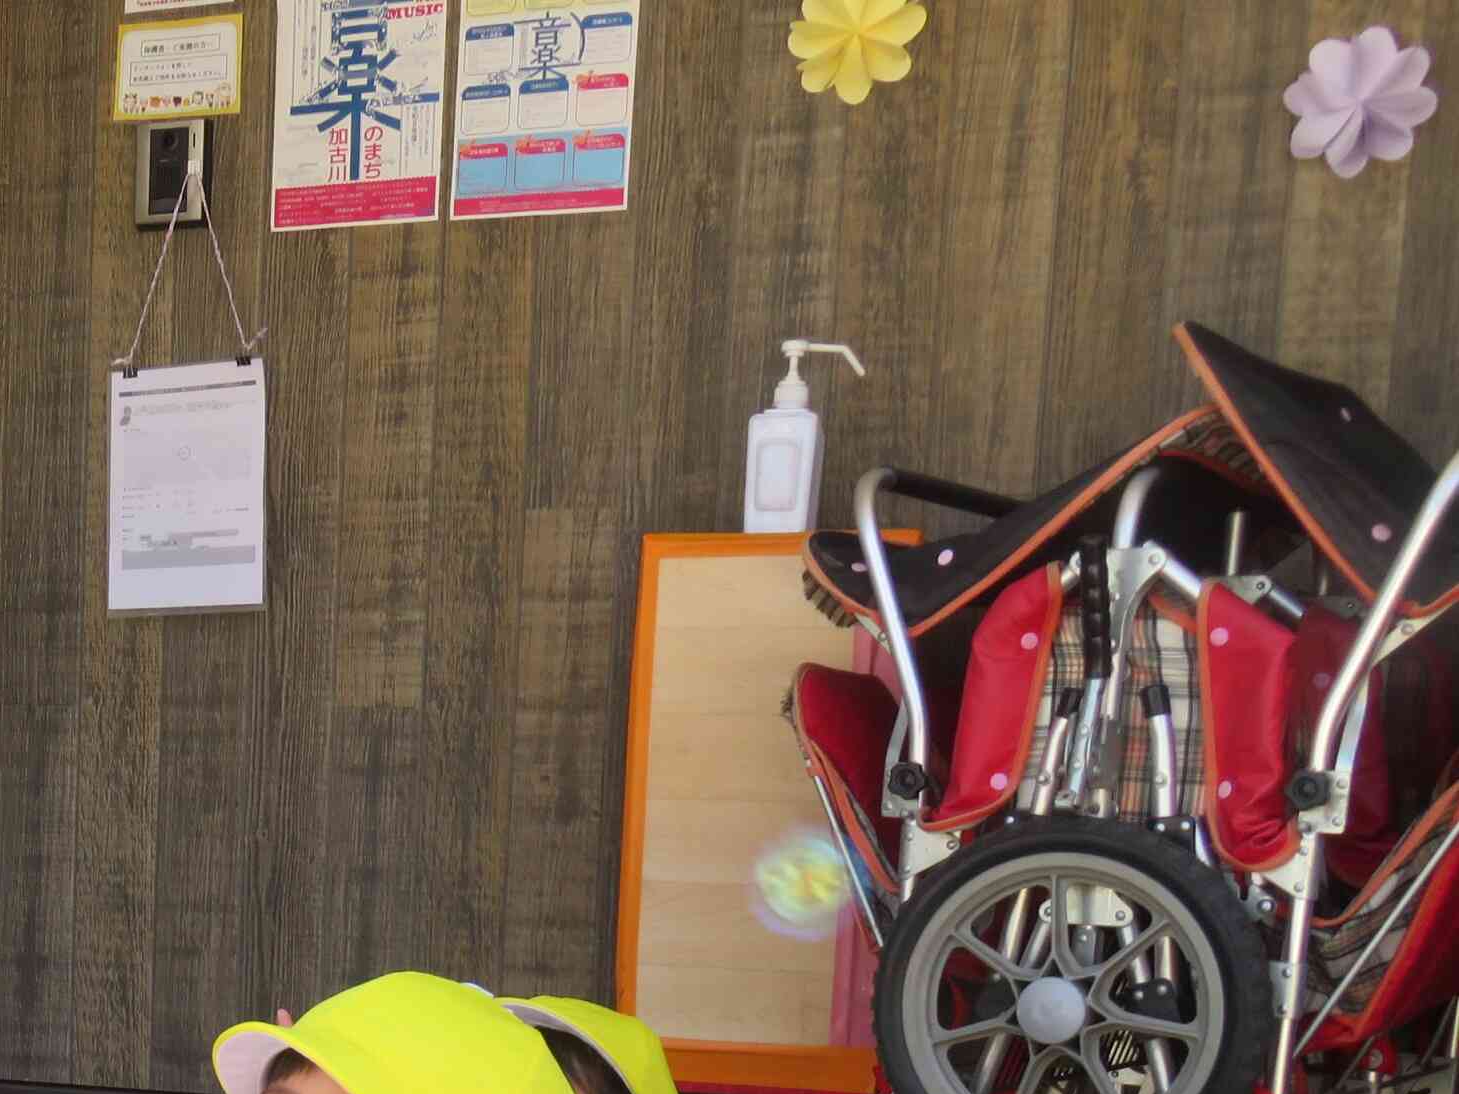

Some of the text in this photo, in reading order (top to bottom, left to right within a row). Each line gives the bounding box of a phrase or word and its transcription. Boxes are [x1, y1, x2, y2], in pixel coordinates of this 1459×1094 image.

[385, 3, 443, 20] MUSIC
[328, 127, 349, 182] 加古川
[364, 125, 384, 180] のまち
